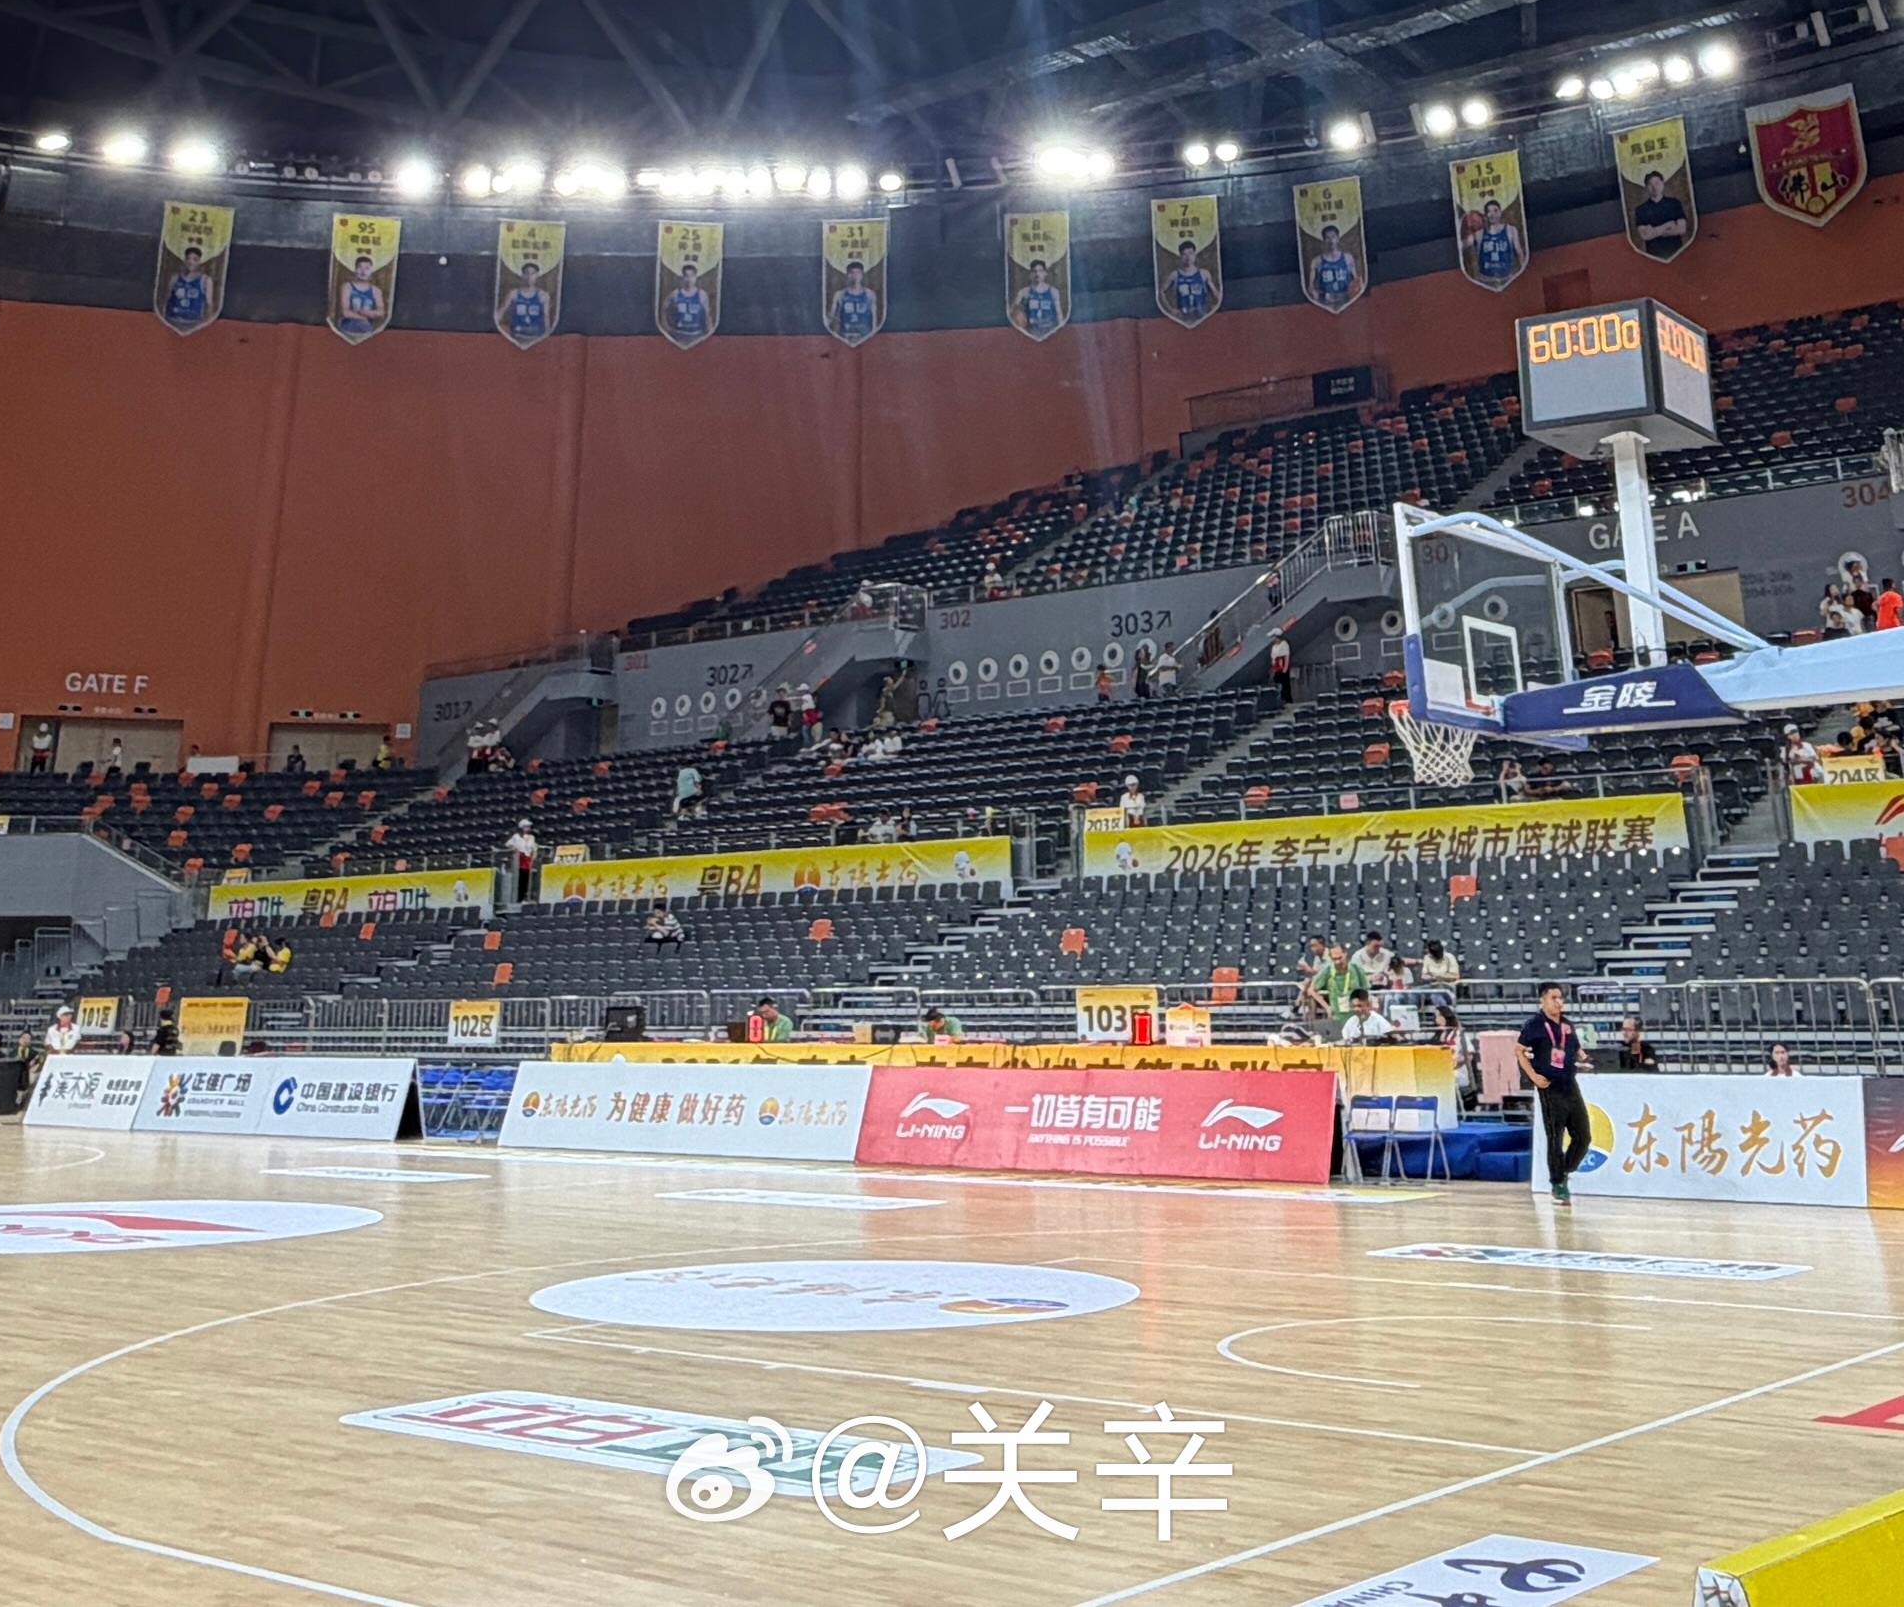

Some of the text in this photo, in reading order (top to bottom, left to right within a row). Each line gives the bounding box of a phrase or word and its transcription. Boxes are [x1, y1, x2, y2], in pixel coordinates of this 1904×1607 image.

[1678, 512, 1700, 538] A
[939, 609, 971, 629] 302
[1110, 613, 1156, 635] 303
[65, 672, 149, 694] GATE F
[706, 663, 741, 686] 302
[1576, 679, 1660, 713] 金陵
[1166, 840, 1263, 872] 2026年
[82, 1006, 111, 1029] 101区
[453, 1015, 493, 1038] 102区
[191, 1072, 252, 1093] 正佳广场
[300, 1081, 400, 1103] 中国建设银行
[606, 1092, 674, 1123] 为健康
[677, 1093, 746, 1126] 做好药
[1004, 1094, 1163, 1134] 一切皆有可能
[896, 1121, 966, 1140] LI-NING
[1197, 1131, 1282, 1153] LI-NING
